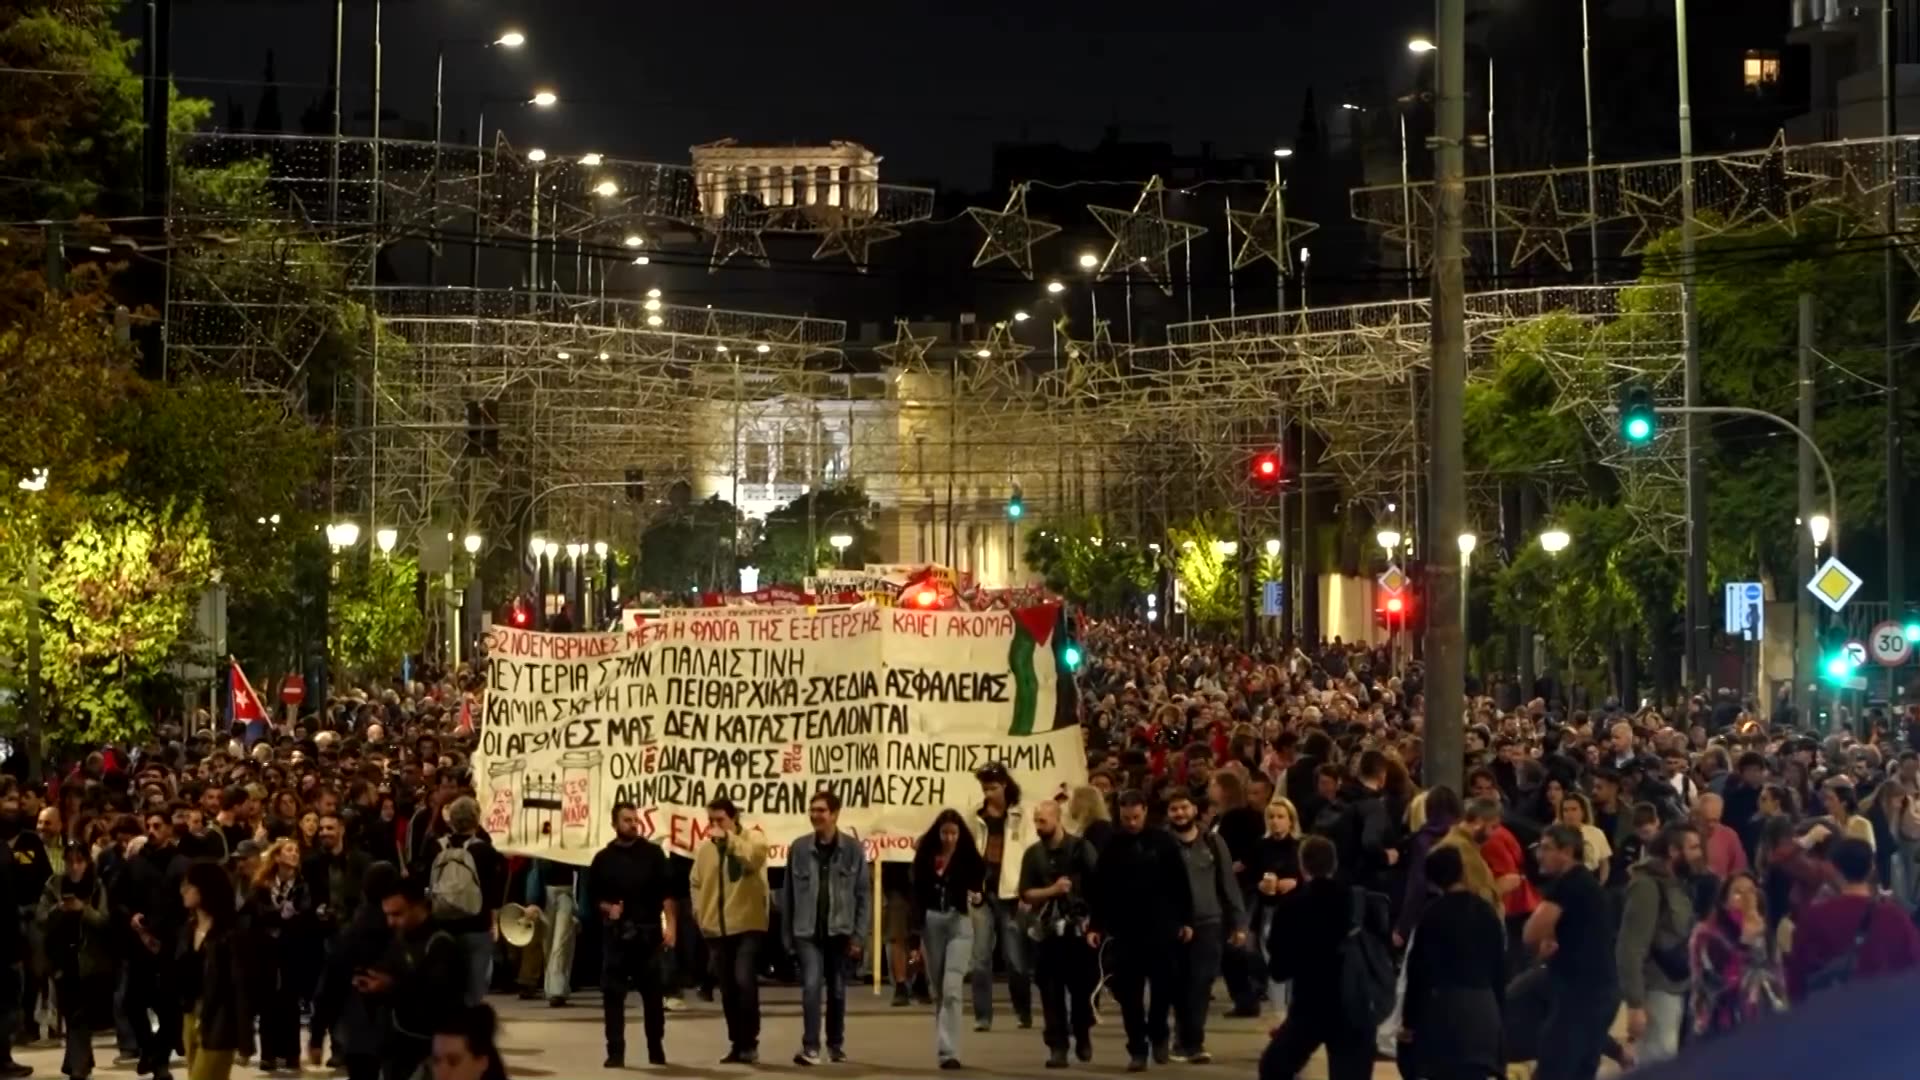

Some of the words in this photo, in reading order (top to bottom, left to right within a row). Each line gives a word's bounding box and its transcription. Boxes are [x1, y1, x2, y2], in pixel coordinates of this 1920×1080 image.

[511, 632, 620, 660] ΝΟΕΜΒΡΗΔΕΣ
[626, 622, 668, 650] ΜΕΤΑ
[673, 621, 685, 638] Η
[690, 619, 740, 642] ΦΛΟΓΑ
[747, 619, 783, 641] ΤΗΣ
[790, 609, 881, 641] ΕΞΕΓΕΡΣΗΣ
[893, 612, 937, 637] ΚΑΙΕΙ
[947, 615, 1013, 637] ΑΚΟΜΑ
[1878, 635, 1903, 652] 30
[598, 651, 652, 685] ΣΤΗΝ
[661, 646, 805, 679] ΠΑΛΑΙΣΤΙΝΗ
[486, 692, 548, 727] ΚΑΜΙΑ
[483, 730, 502, 757] ΟΙ
[506, 718, 602, 758] ΑΓΩΝΕΣ
[607, 715, 657, 746] ΜΑΣ
[664, 709, 709, 741] ΔΕΝ
[715, 703, 908, 744] ΚΑΤΑΣΤΕΛΛΟΝΤΑΙ
[609, 752, 643, 780] ΟΧΙ
[658, 745, 781, 780] ΔΙΑΓΡΑΦΕΣ
[809, 742, 879, 775] ΙΔΙΩΤΙΚΑ
[887, 740, 1056, 773] ΠΑΝΕΠΙΣΤΗΜΙΑ
[614, 774, 706, 809] ΔΗΜΟΣΙΑ
